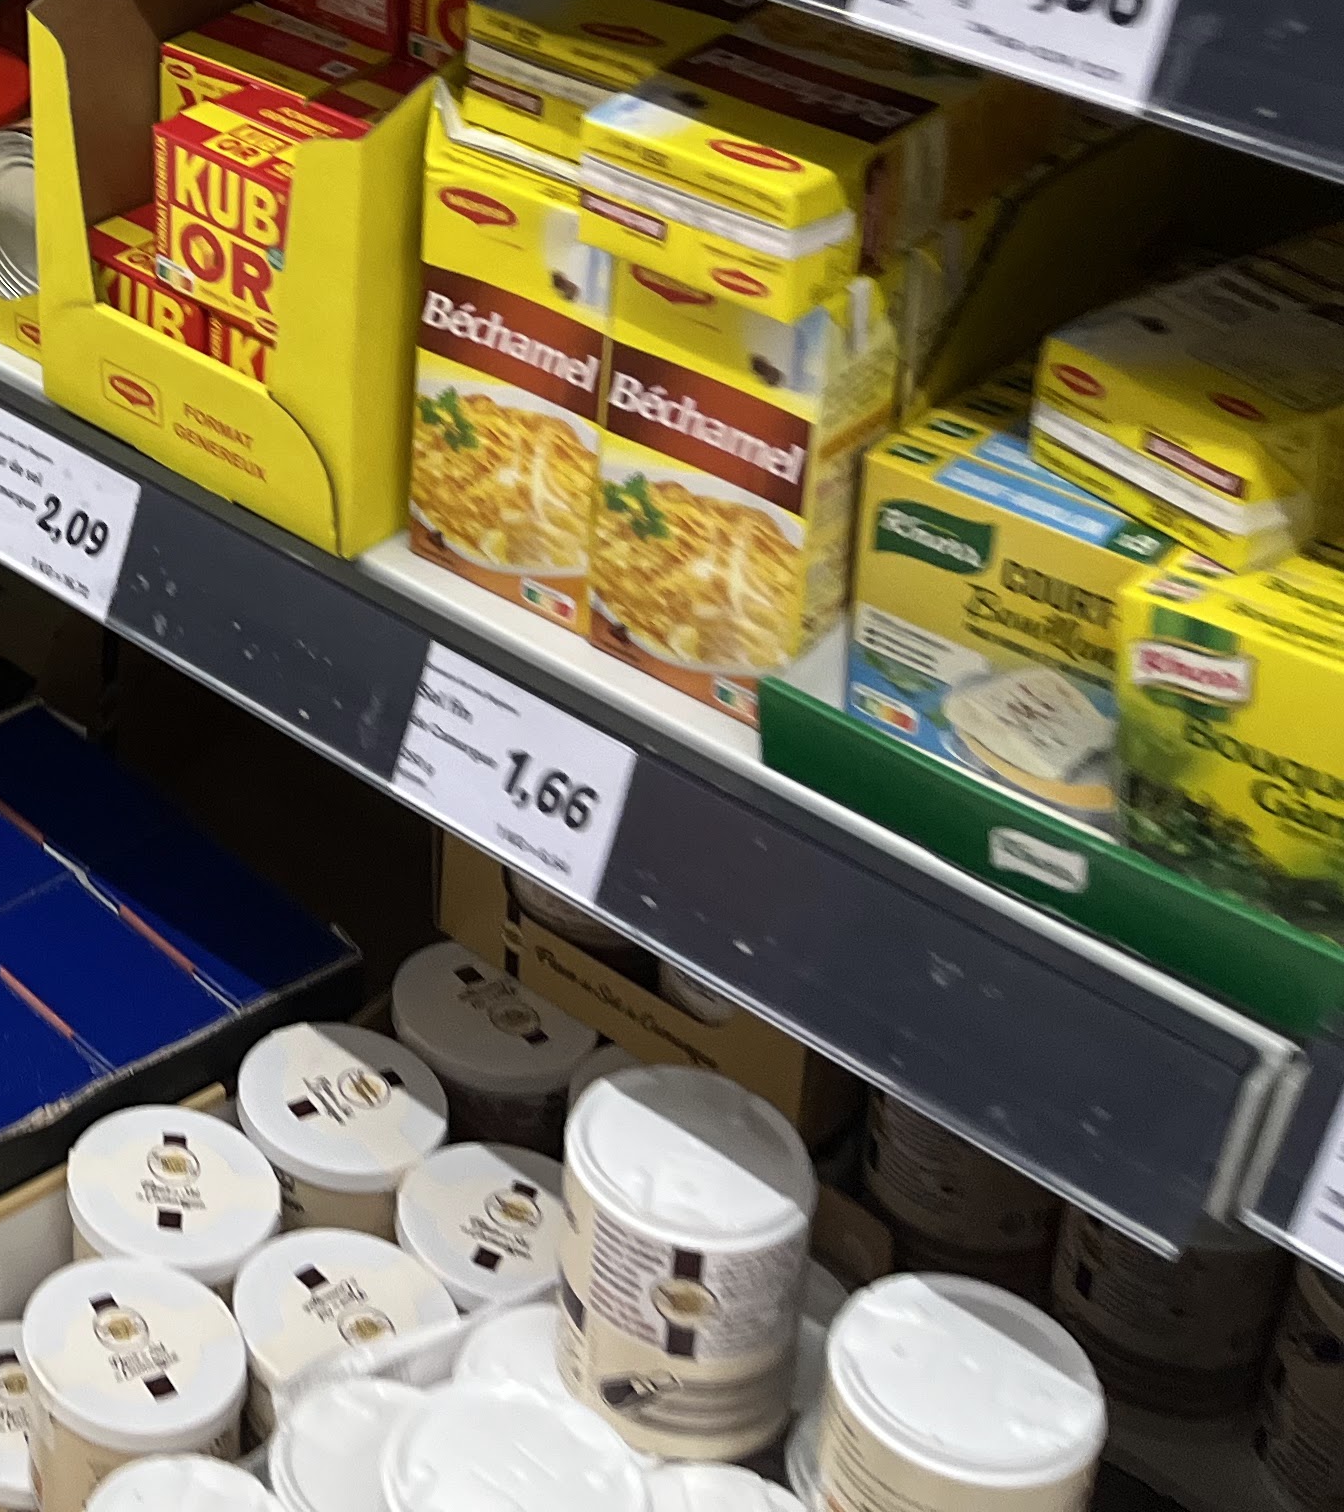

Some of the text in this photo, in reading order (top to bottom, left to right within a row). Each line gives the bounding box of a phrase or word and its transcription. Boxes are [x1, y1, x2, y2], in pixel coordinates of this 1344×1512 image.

[173, 144, 280, 247] KUB
[179, 221, 273, 314] OR
[422, 290, 601, 394] Béchamel
[173, 421, 268, 484] GENEREUX
[184, 401, 254, 450] FORMAT
[609, 372, 808, 484] Béchamel
[36, 493, 109, 556] 2,09
[505, 747, 600, 833] 1,66
